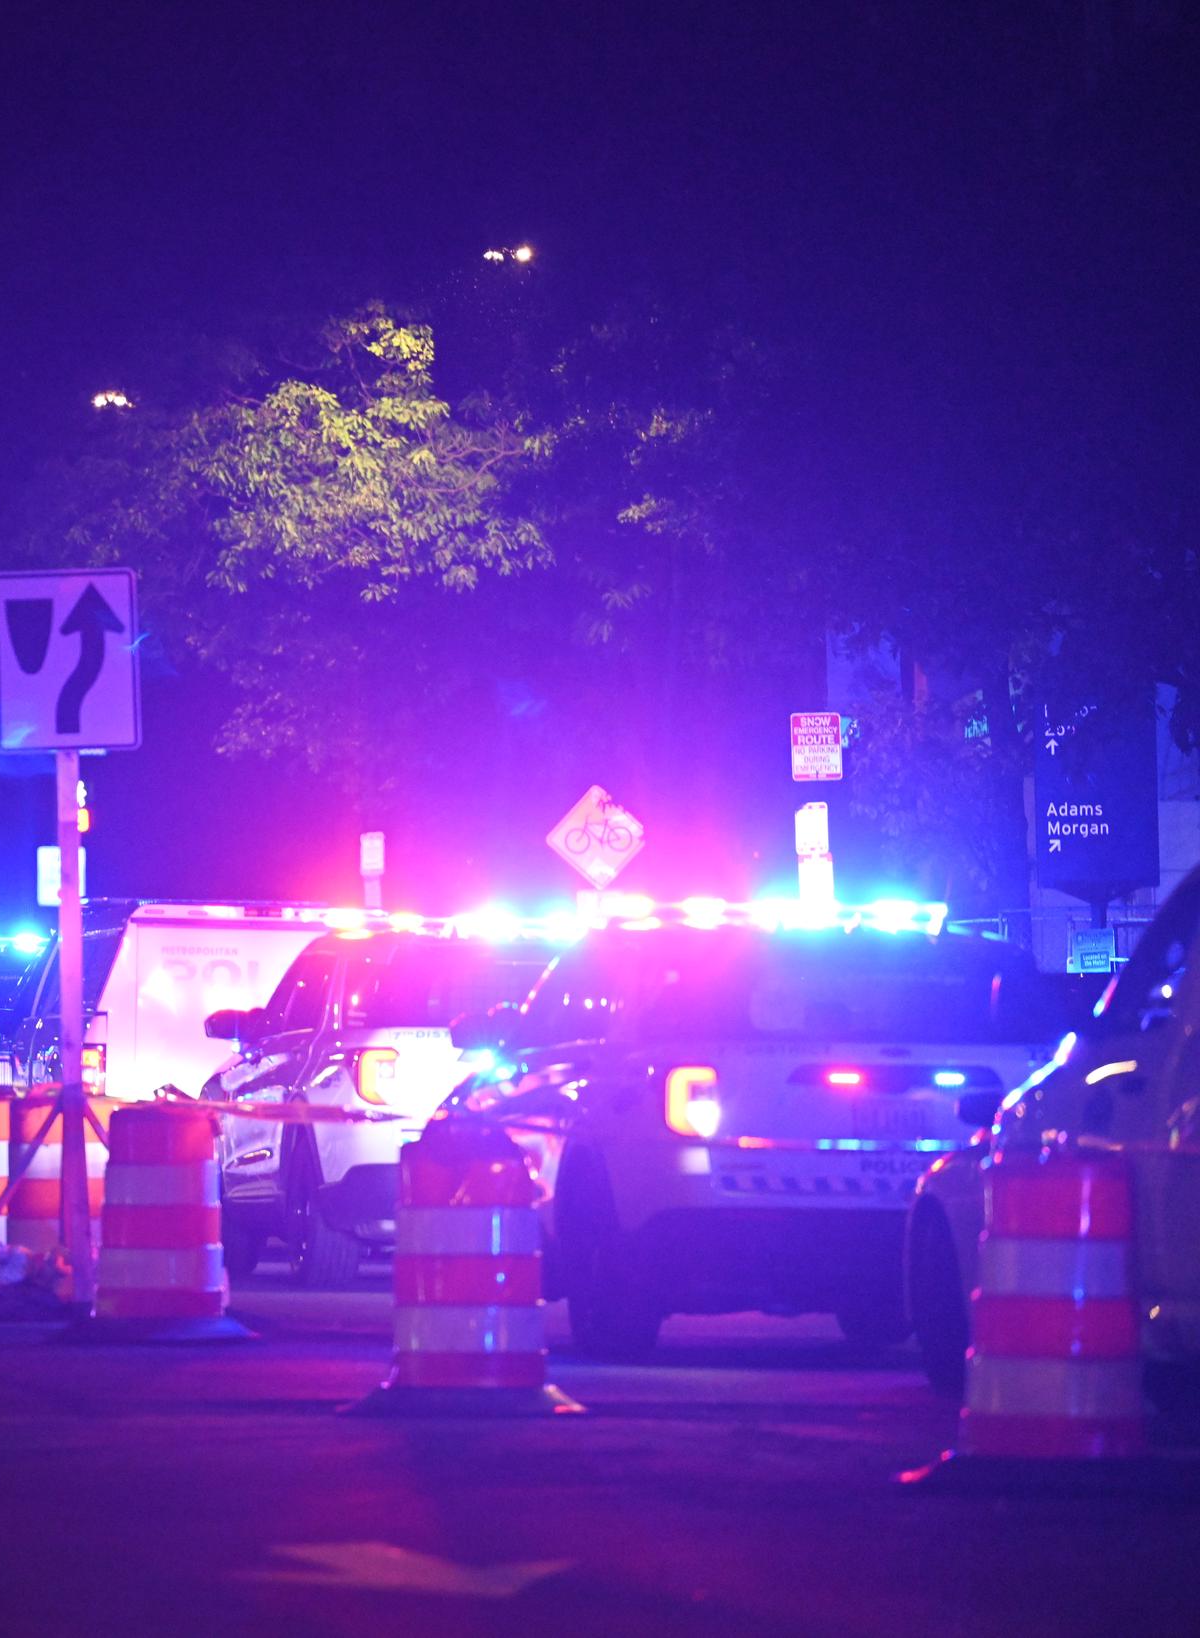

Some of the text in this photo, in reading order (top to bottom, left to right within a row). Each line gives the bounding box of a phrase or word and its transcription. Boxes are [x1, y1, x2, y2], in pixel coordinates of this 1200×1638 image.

[800, 716, 831, 727] SNOW
[793, 727, 838, 735] EMERGENCY
[798, 734, 835, 746] ROUTE
[794, 745, 839, 755] NO PARKING
[803, 755, 831, 764] DURING
[1046, 802, 1103, 817] Adams
[1047, 821, 1109, 838] Morgan
[160, 945, 239, 956] METROPOLITAN
